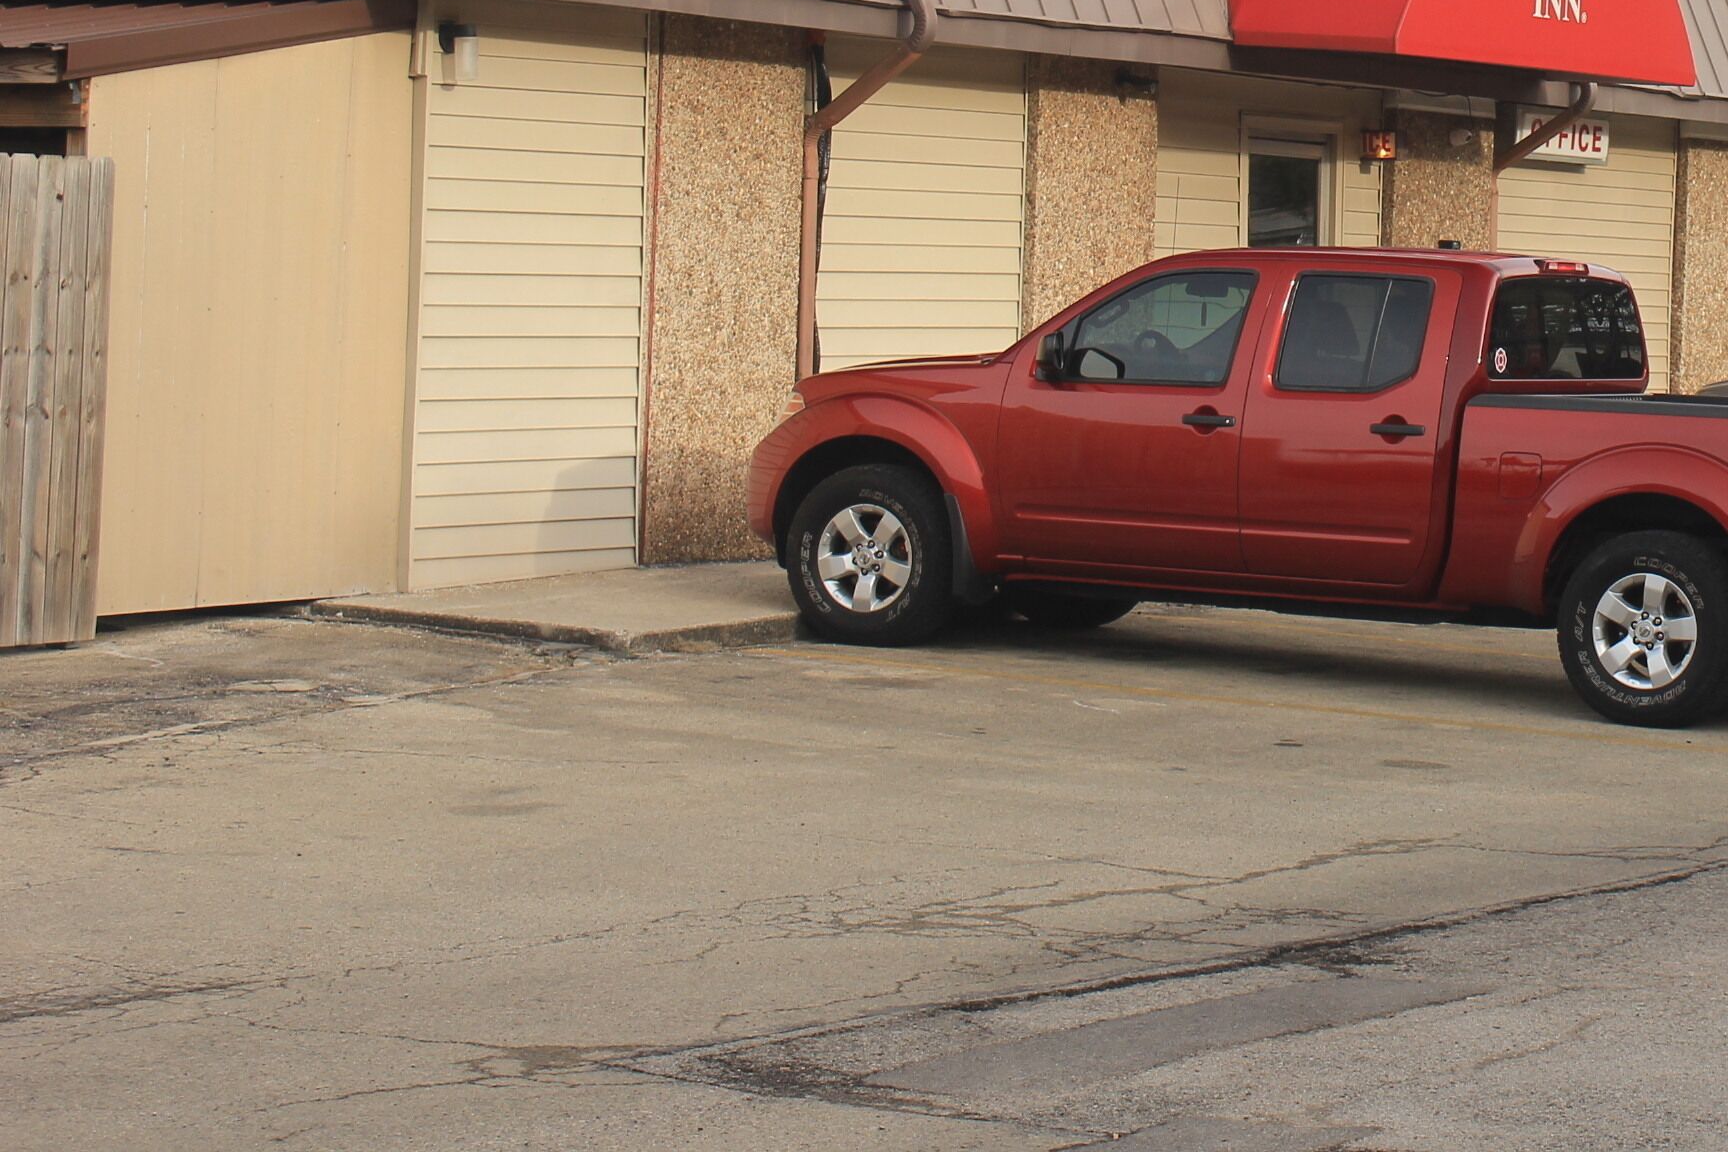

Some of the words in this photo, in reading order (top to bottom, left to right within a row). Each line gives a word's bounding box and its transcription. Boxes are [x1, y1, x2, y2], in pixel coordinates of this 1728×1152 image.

[1363, 133, 1392, 152] ICE
[1531, 118, 1603, 153] OFICE
[801, 530, 832, 614] COOPER
[1633, 556, 1705, 610] COOPER
